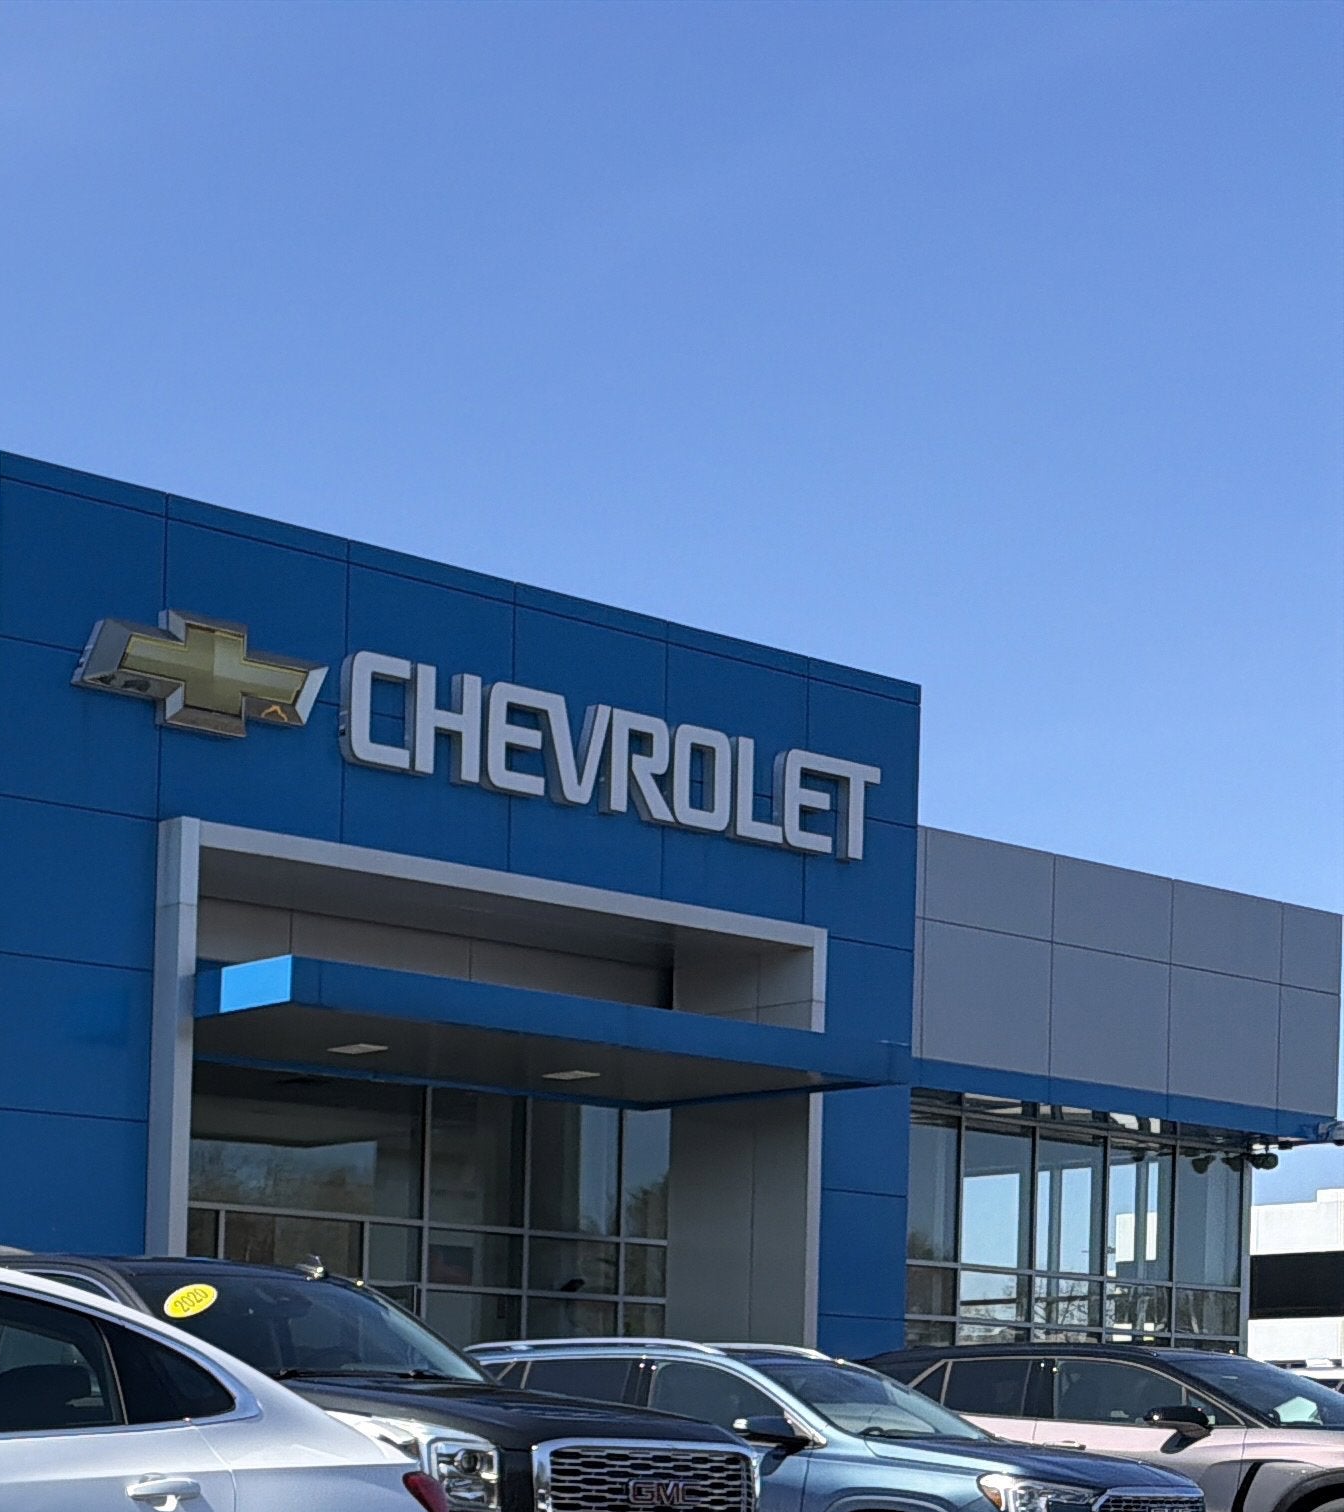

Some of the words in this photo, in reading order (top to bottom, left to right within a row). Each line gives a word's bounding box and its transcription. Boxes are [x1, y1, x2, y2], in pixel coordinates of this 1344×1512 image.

[341, 650, 882, 861] CHEVROLET
[173, 1288, 209, 1313] 2020
[628, 1479, 703, 1506] GMC
